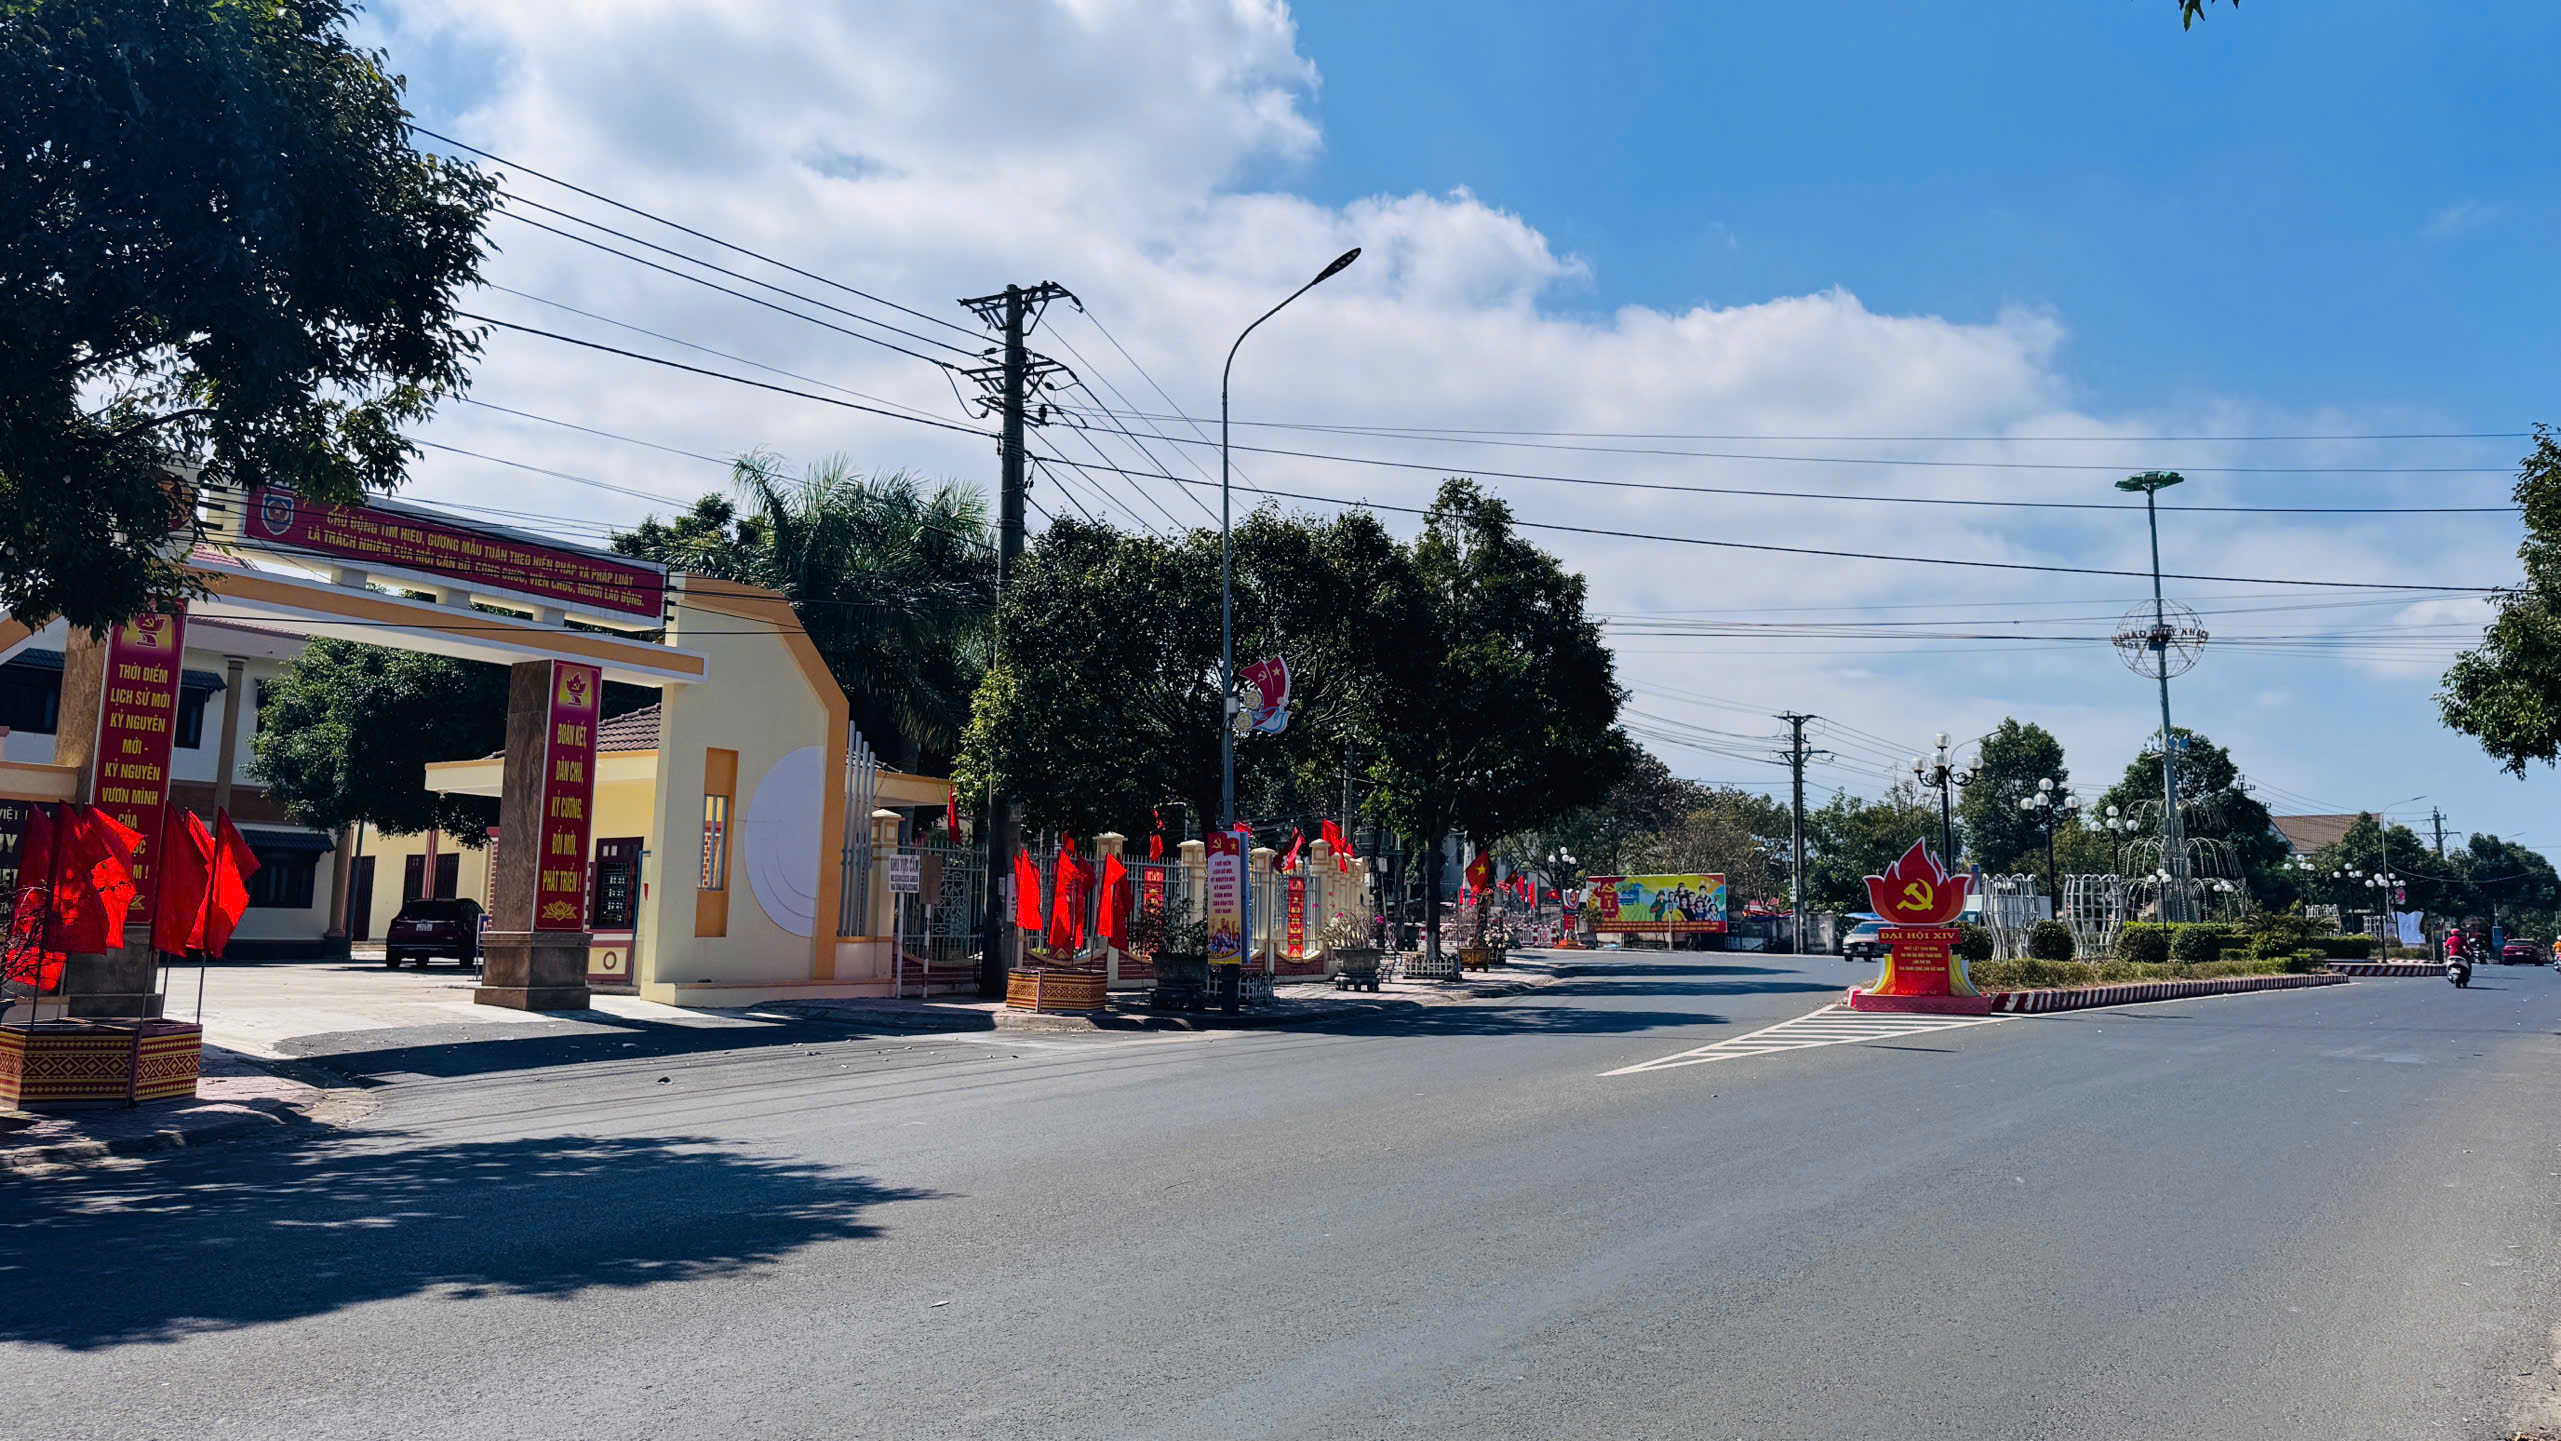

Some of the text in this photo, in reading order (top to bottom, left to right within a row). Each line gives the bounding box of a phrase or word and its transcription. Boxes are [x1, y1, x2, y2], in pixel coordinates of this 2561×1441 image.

[327, 511, 348, 528] CHỦ
[350, 515, 378, 534] ĐỘNG
[381, 521, 398, 539] TÌM
[427, 533, 459, 552] GƯƠNG
[461, 537, 482, 557] MẪU
[484, 545, 508, 562] TUÂN
[510, 551, 531, 566] THEO
[533, 554, 553, 571] HIẾN
[554, 560, 577, 576] PHÁP
[579, 564, 590, 579] VÀ
[591, 568, 613, 583] PHÁP
[614, 573, 635, 589] LUẬT
[307, 525, 320, 541] LÀ
[324, 530, 357, 549] TRÁCH
[359, 537, 392, 556] NHIỆM
[394, 542, 413, 560] CỦA
[436, 553, 456, 569] CÁN
[502, 567, 527, 584] CHỨC,
[529, 572, 549, 588] VIÊN
[604, 587, 619, 601] LAO
[620, 590, 645, 607] ĐỘNG.
[119, 661, 168, 684] THỜI ĐIỂM
[111, 687, 171, 708] LỊCH SỬ MỚI
[110, 709, 166, 733] KỶ NGUYÊN
[122, 737, 142, 755] MỚI
[557, 720, 588, 750] ĐOÀN KẾT,
[104, 758, 161, 781] KỶ NGUYÊN
[555, 755, 584, 786] DÂN CHỦ,
[102, 786, 159, 806] VƯƠN MÌNH
[551, 789, 583, 822] KỶ CƯƠNG,
[118, 809, 138, 829] CỦA
[551, 825, 577, 858] ĐỔI MỚI,
[542, 866, 559, 892] PHÁT
[560, 862, 578, 893] TRIỂN
[1881, 932, 1902, 940] ĐẠI
[1906, 931, 1929, 940] HỘI
